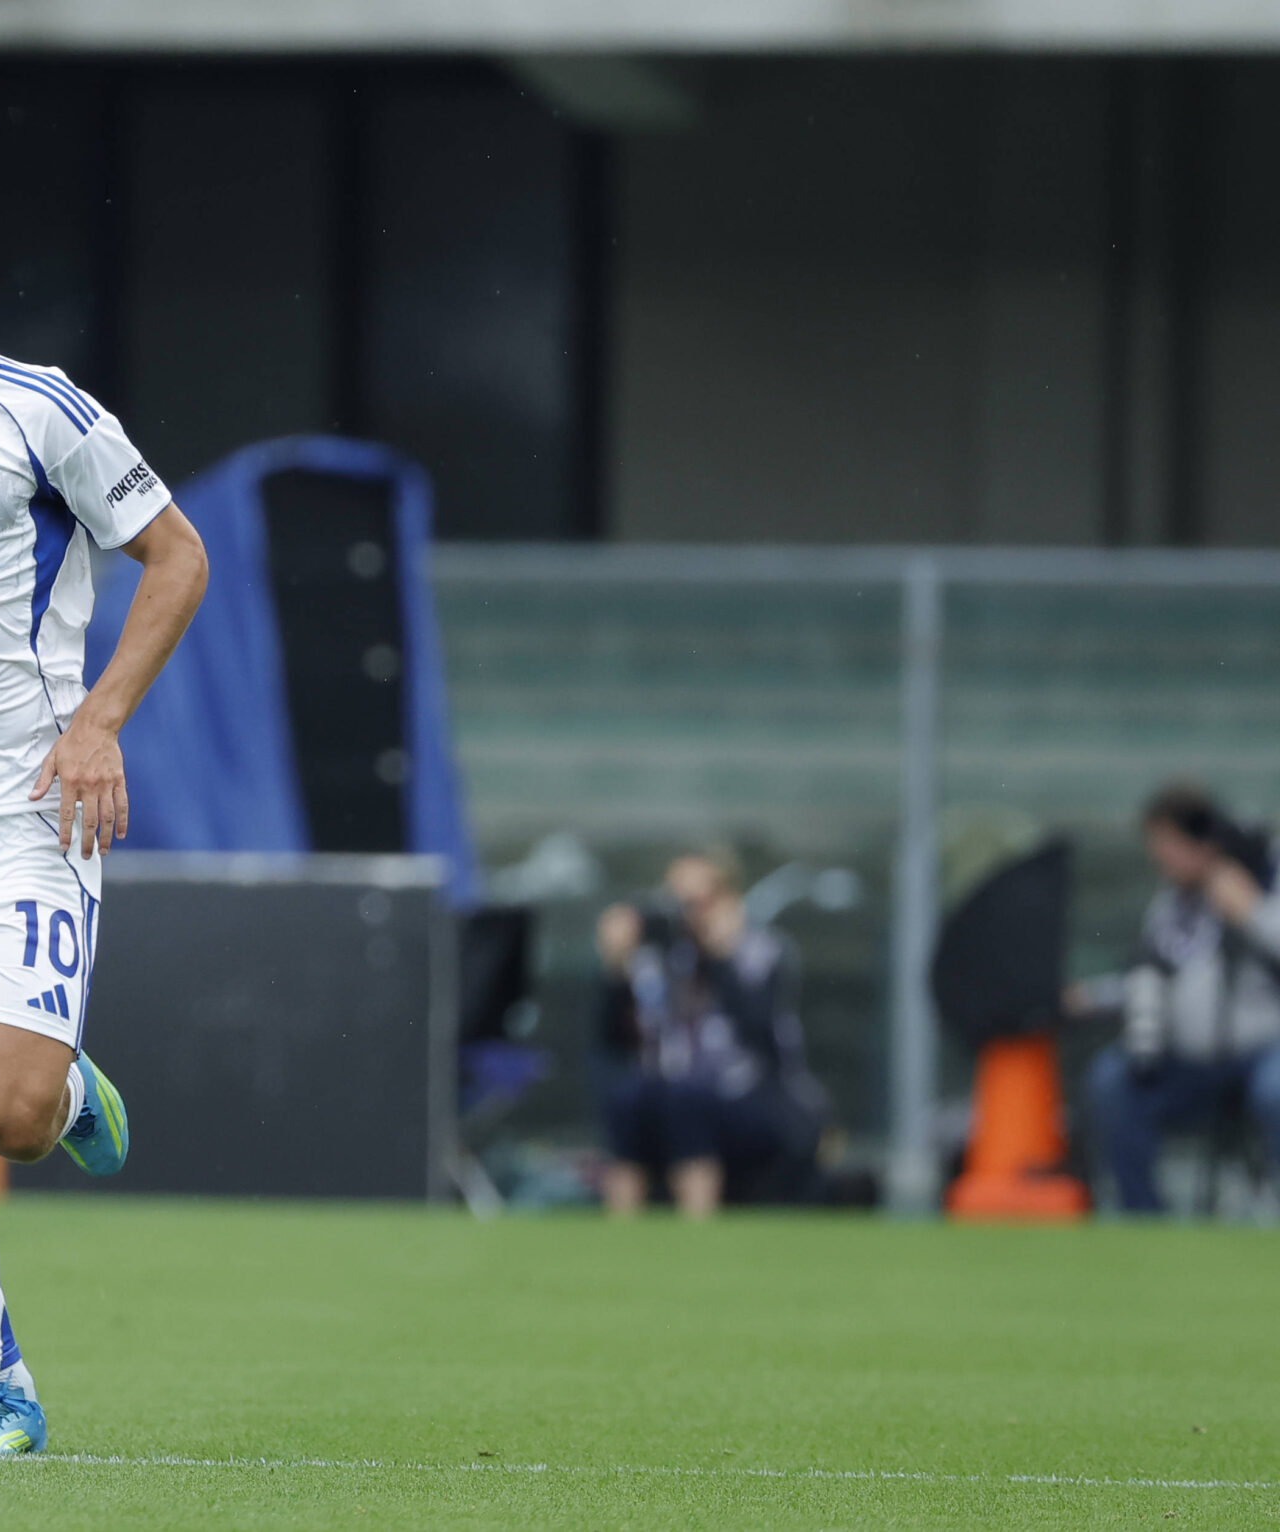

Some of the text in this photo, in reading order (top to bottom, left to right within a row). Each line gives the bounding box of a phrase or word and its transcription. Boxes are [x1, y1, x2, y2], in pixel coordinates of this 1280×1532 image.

[106, 459, 149, 509] POKERS
[137, 474, 158, 496] NEWS
[15, 900, 79, 978] 10
